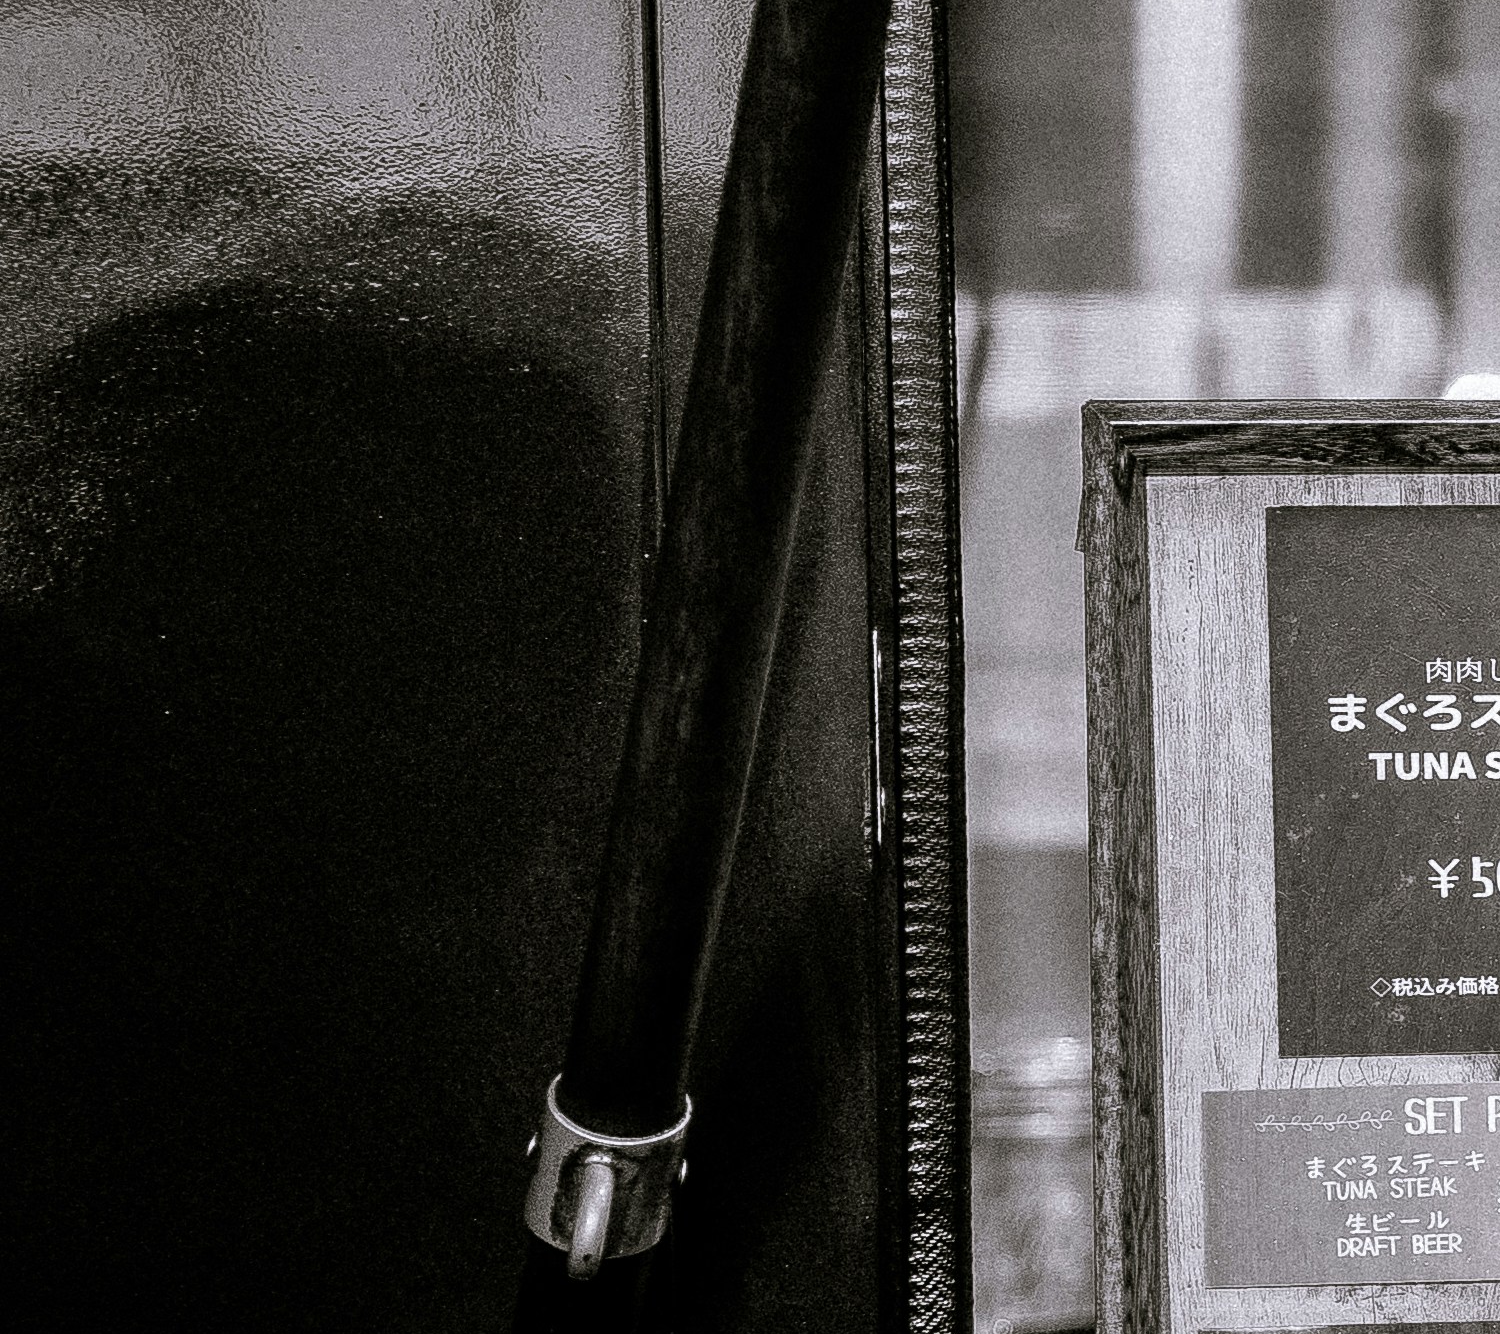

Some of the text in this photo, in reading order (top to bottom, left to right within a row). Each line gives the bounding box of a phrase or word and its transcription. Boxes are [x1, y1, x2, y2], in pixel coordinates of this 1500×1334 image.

[1368, 751, 1477, 782] TUNA
[1404, 1095, 1469, 1136] SET
[1305, 1150, 1487, 1180] まぐろステーキ
[1322, 1177, 1458, 1202] TUNA STEAK
[1345, 1210, 1451, 1235] 生ビール
[1336, 1232, 1463, 1259] DRAFT BEER
